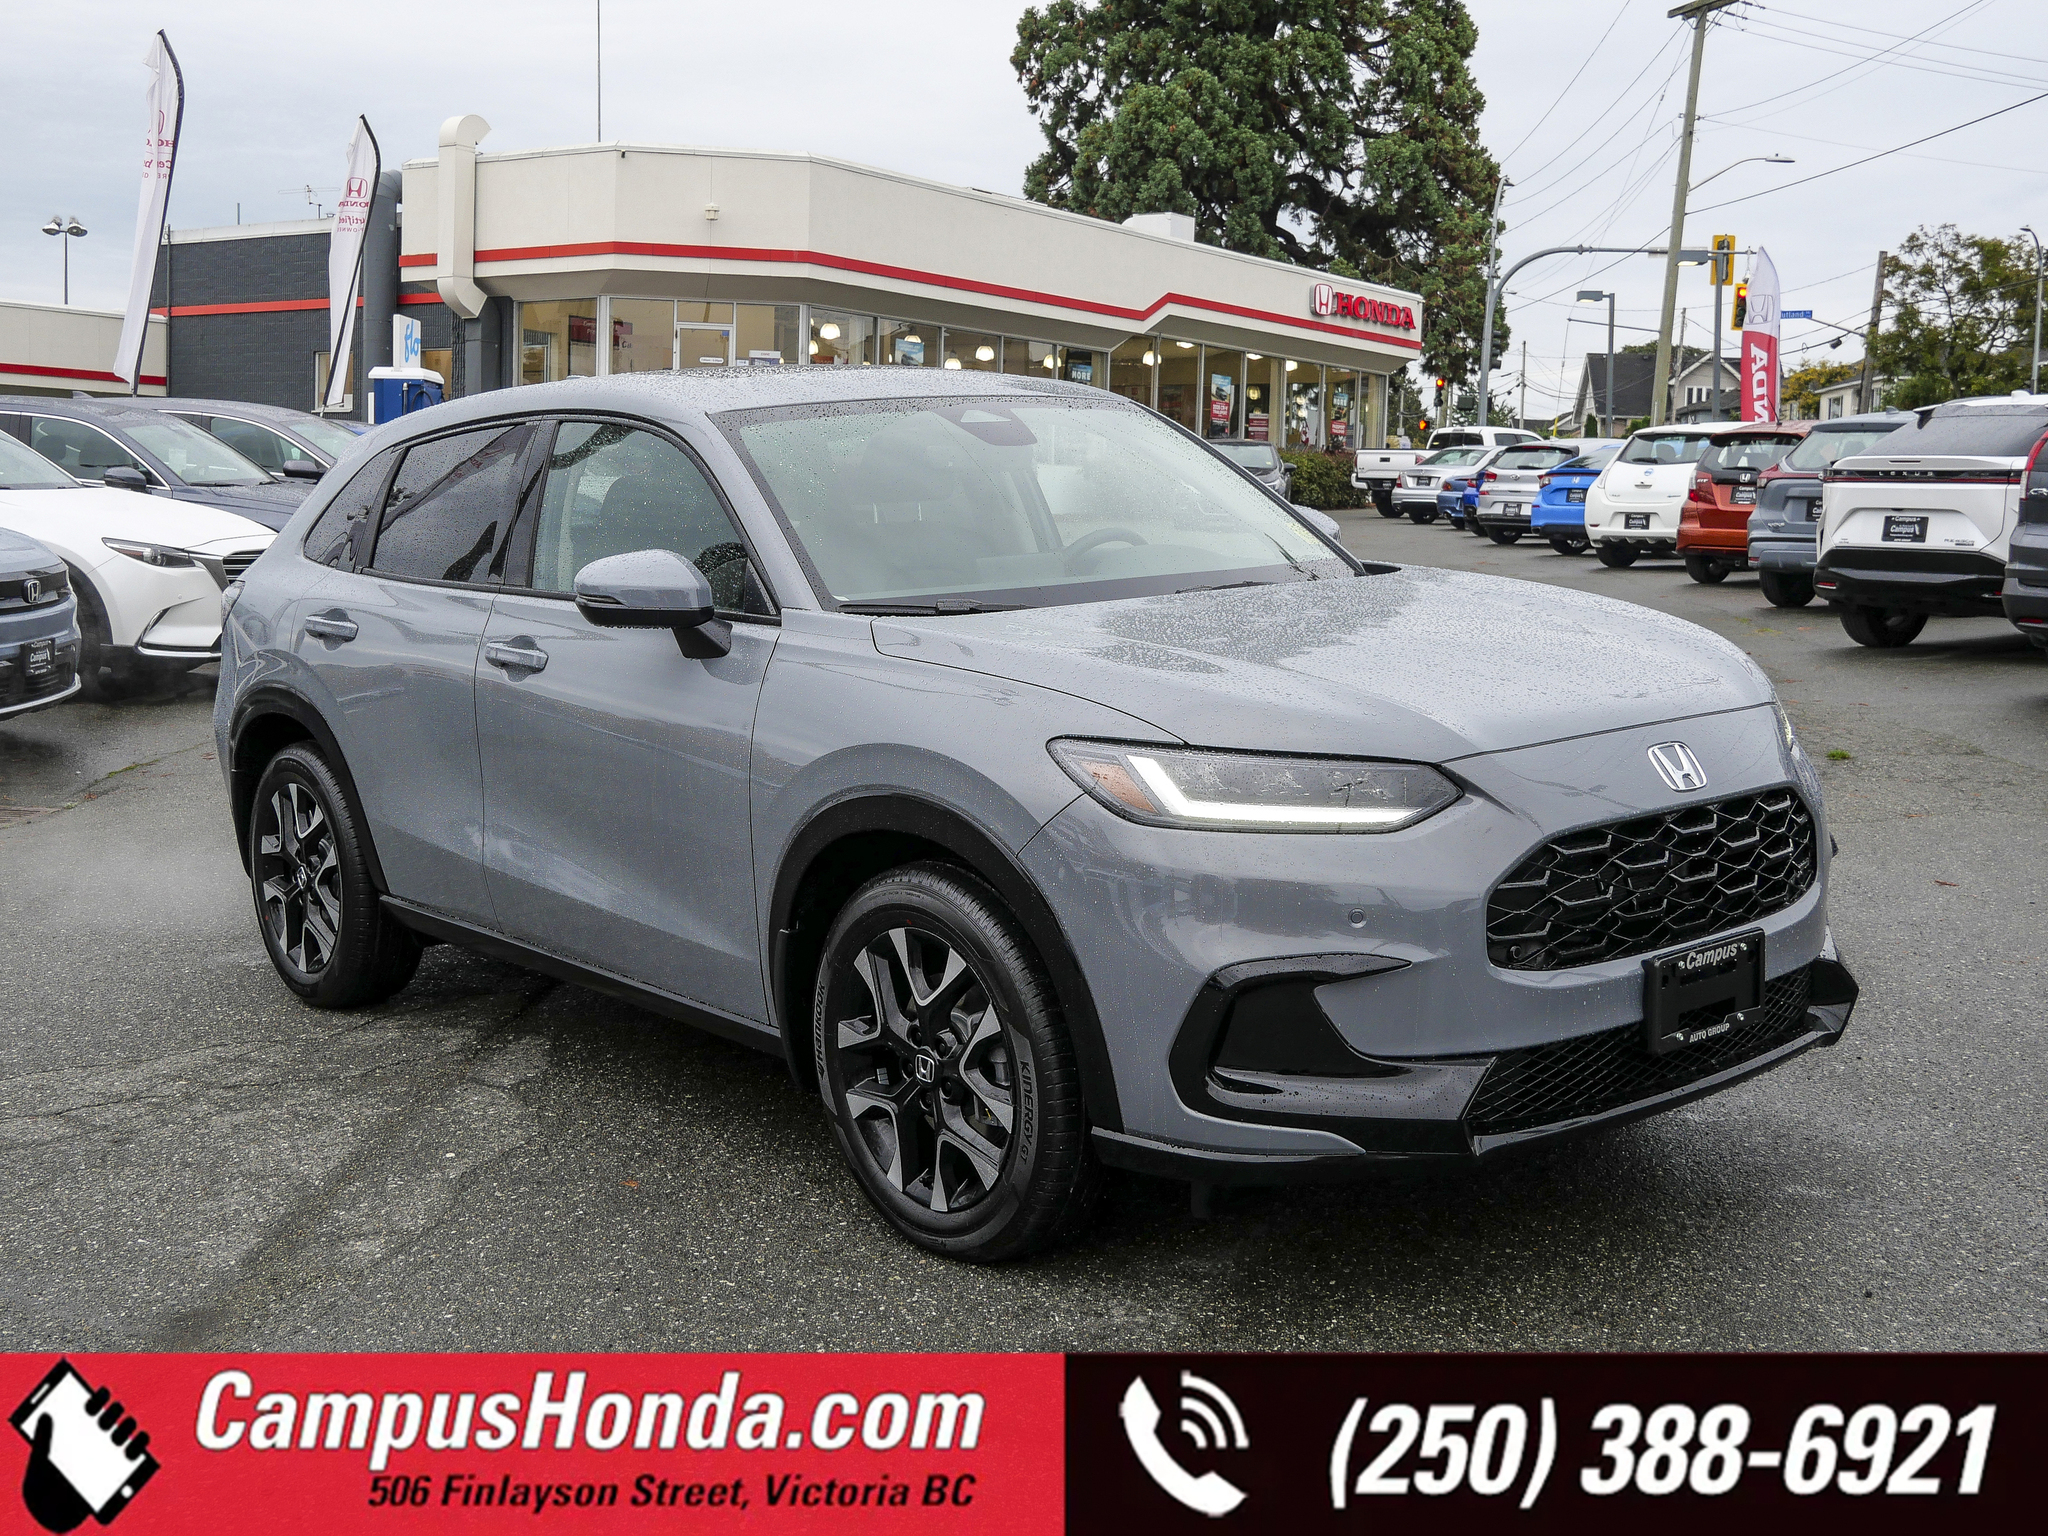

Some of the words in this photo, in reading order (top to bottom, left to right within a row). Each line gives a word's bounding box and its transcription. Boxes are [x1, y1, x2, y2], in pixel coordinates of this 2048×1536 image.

[1335, 292, 1416, 329] HONDA
[1781, 310, 1804, 318] utland
[404, 319, 421, 363] flo
[1071, 370, 1091, 380] MORE
[1890, 525, 1914, 533] Campus
[1686, 943, 1738, 970] Campus
[1689, 1030, 1707, 1043] AUTO
[1707, 1023, 1730, 1037] GROUP
[1020, 1061, 1034, 1145] KINERGY
